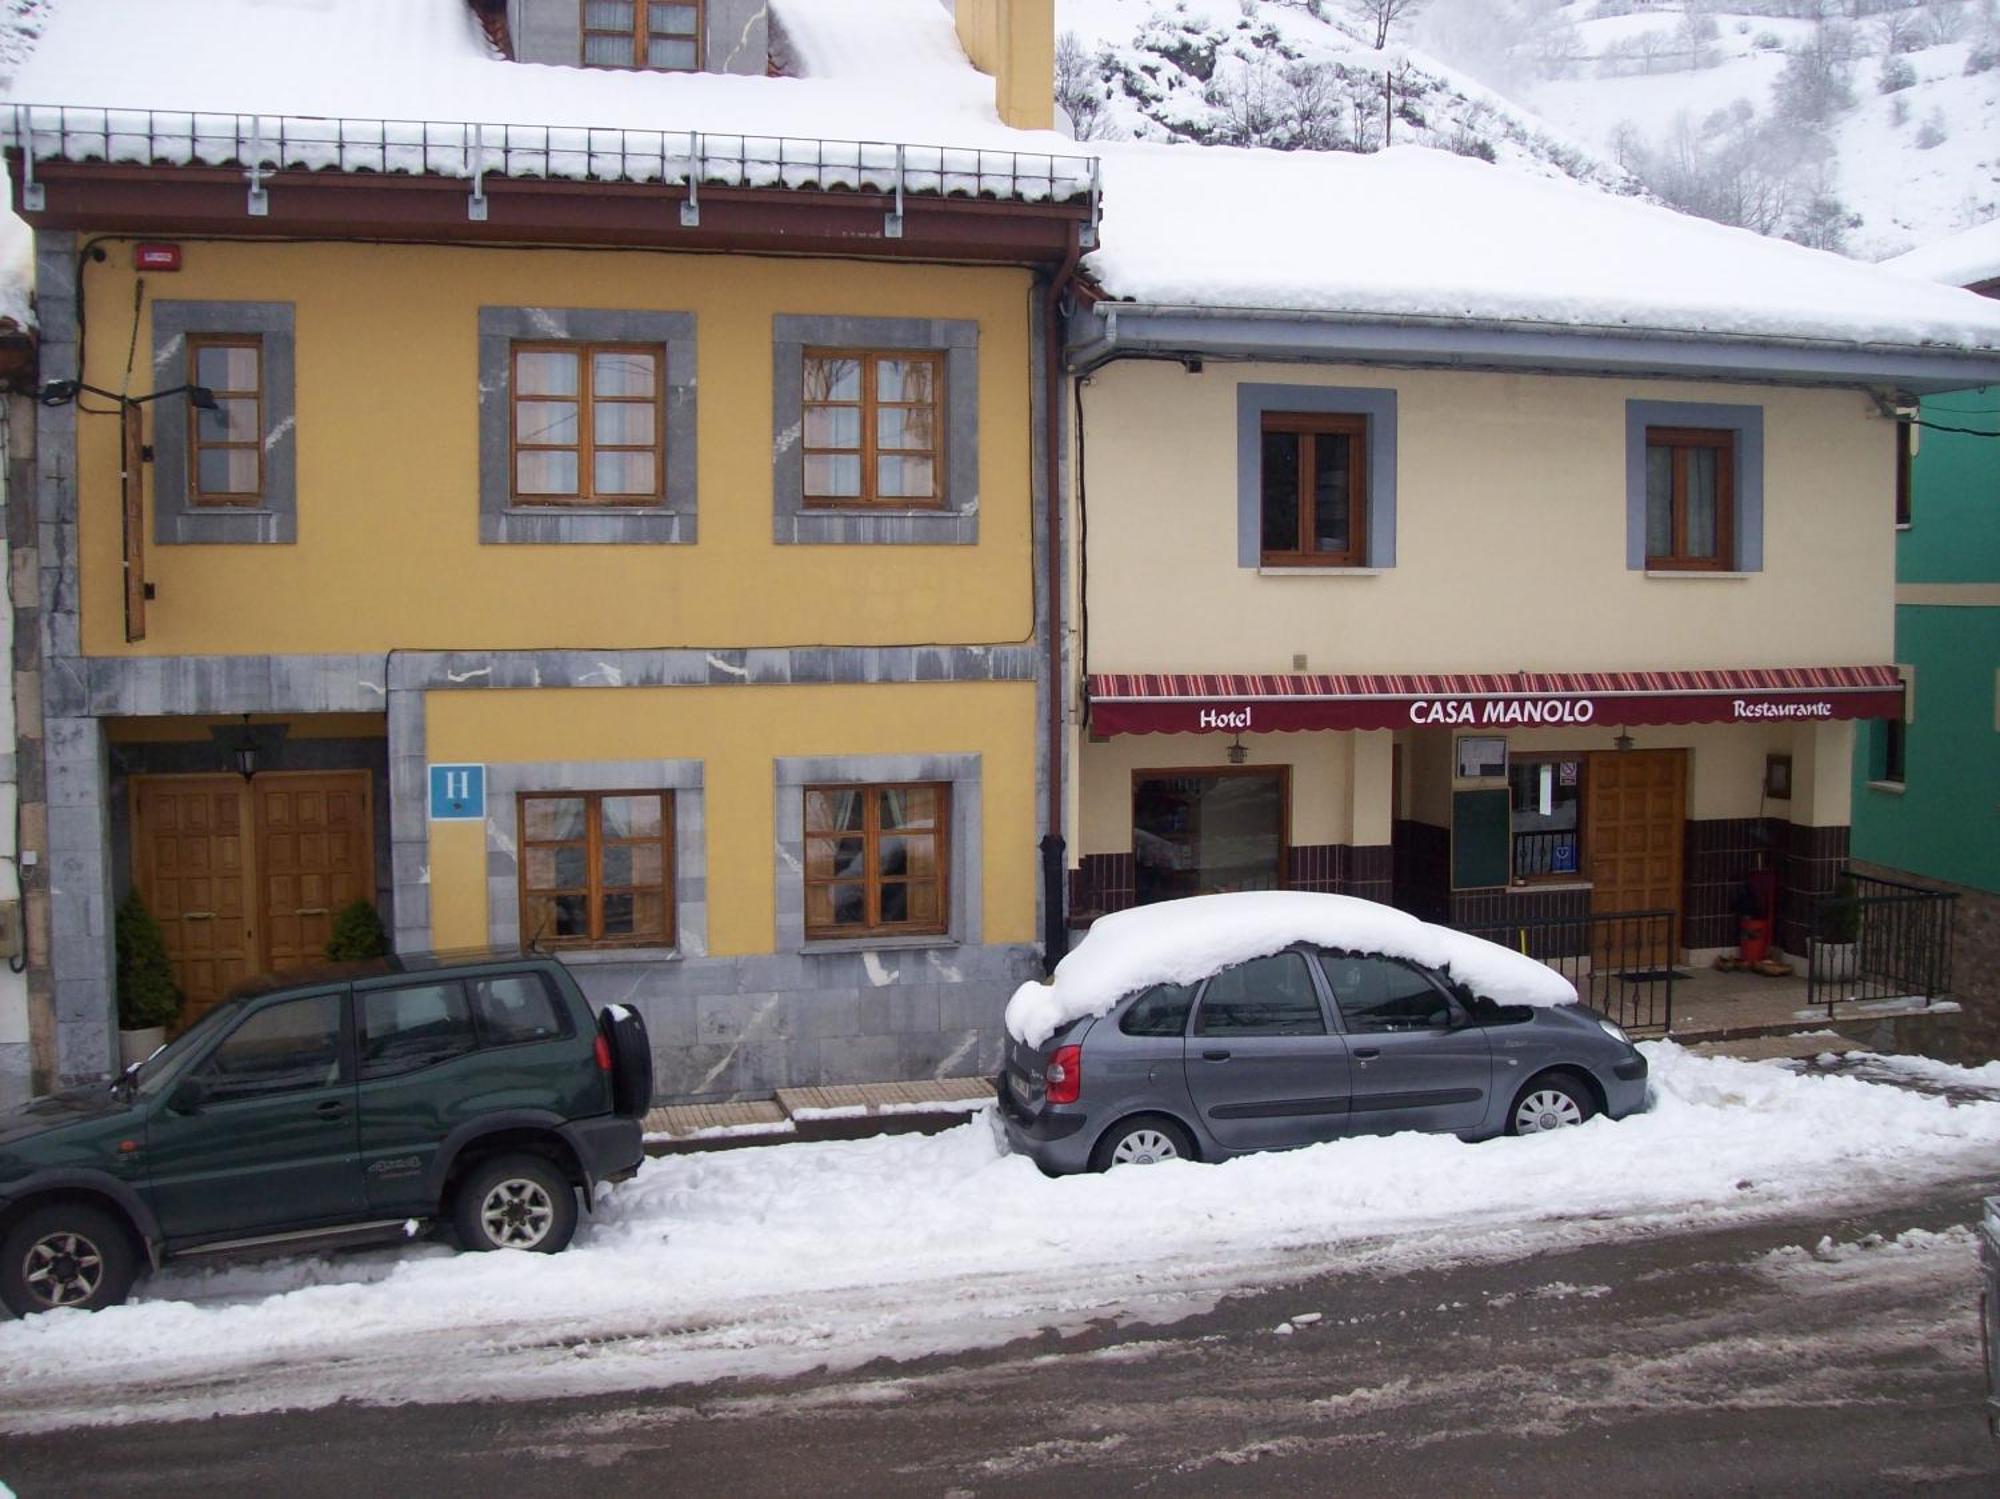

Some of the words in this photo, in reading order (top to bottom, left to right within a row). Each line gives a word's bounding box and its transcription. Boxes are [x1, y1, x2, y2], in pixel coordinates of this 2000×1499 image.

[1200, 706, 1251, 728] Hotel
[1409, 700, 1476, 724] CASA
[1481, 699, 1594, 724] MANOLO
[1732, 700, 1831, 718] Restaurante
[446, 771, 470, 799] H
